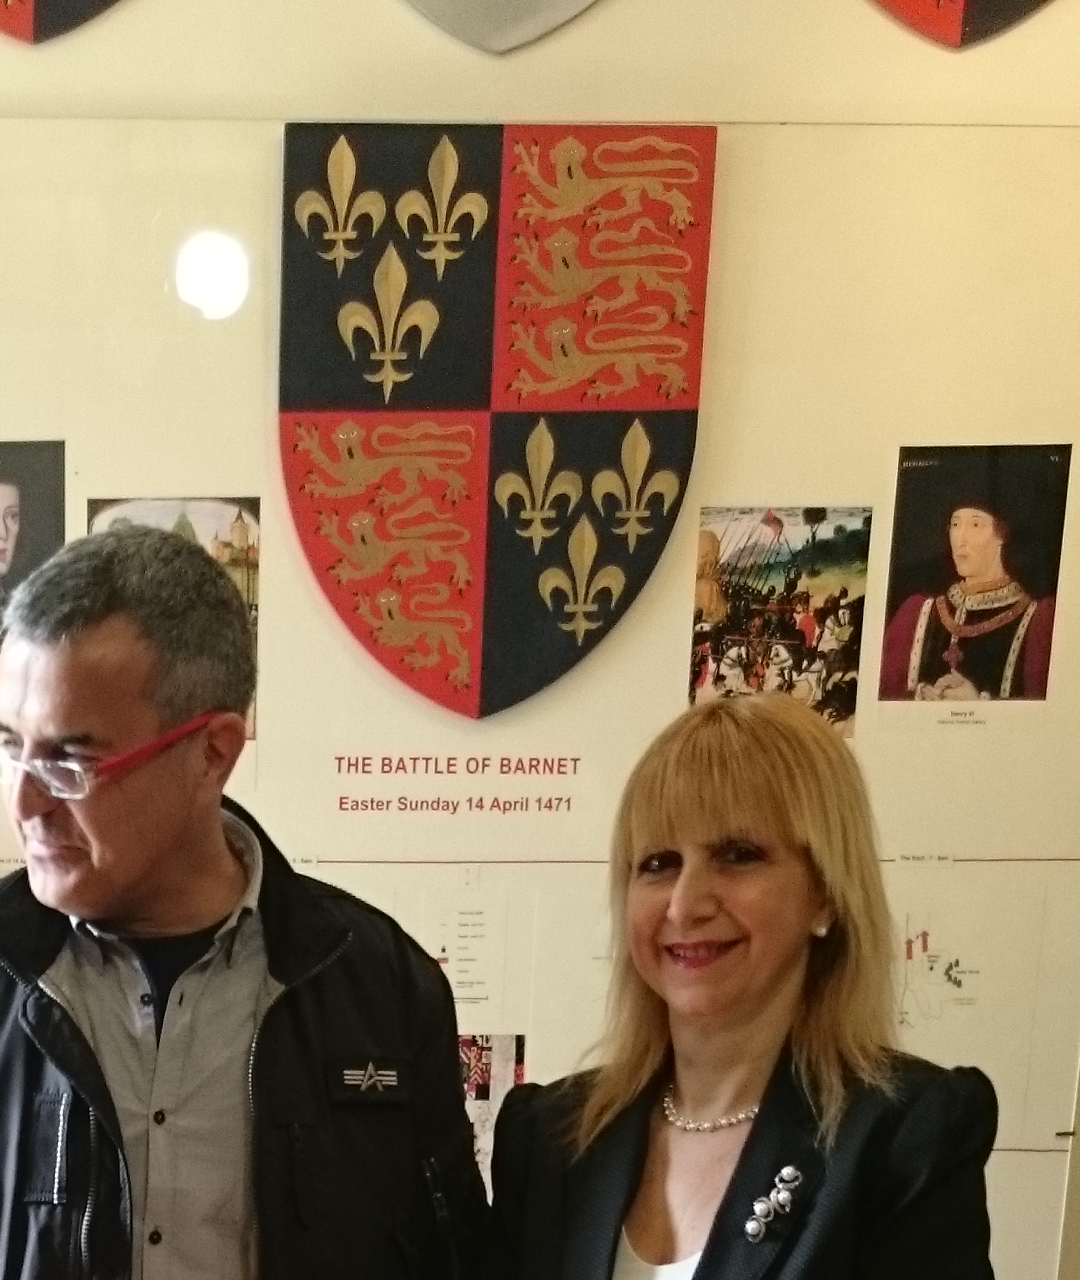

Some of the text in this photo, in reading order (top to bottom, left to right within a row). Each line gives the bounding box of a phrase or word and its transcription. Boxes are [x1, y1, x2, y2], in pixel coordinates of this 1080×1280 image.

[335, 757, 581, 775] THE BATTLE OF BARNET
[338, 797, 572, 815] Easter Sunday 14 April 1471
